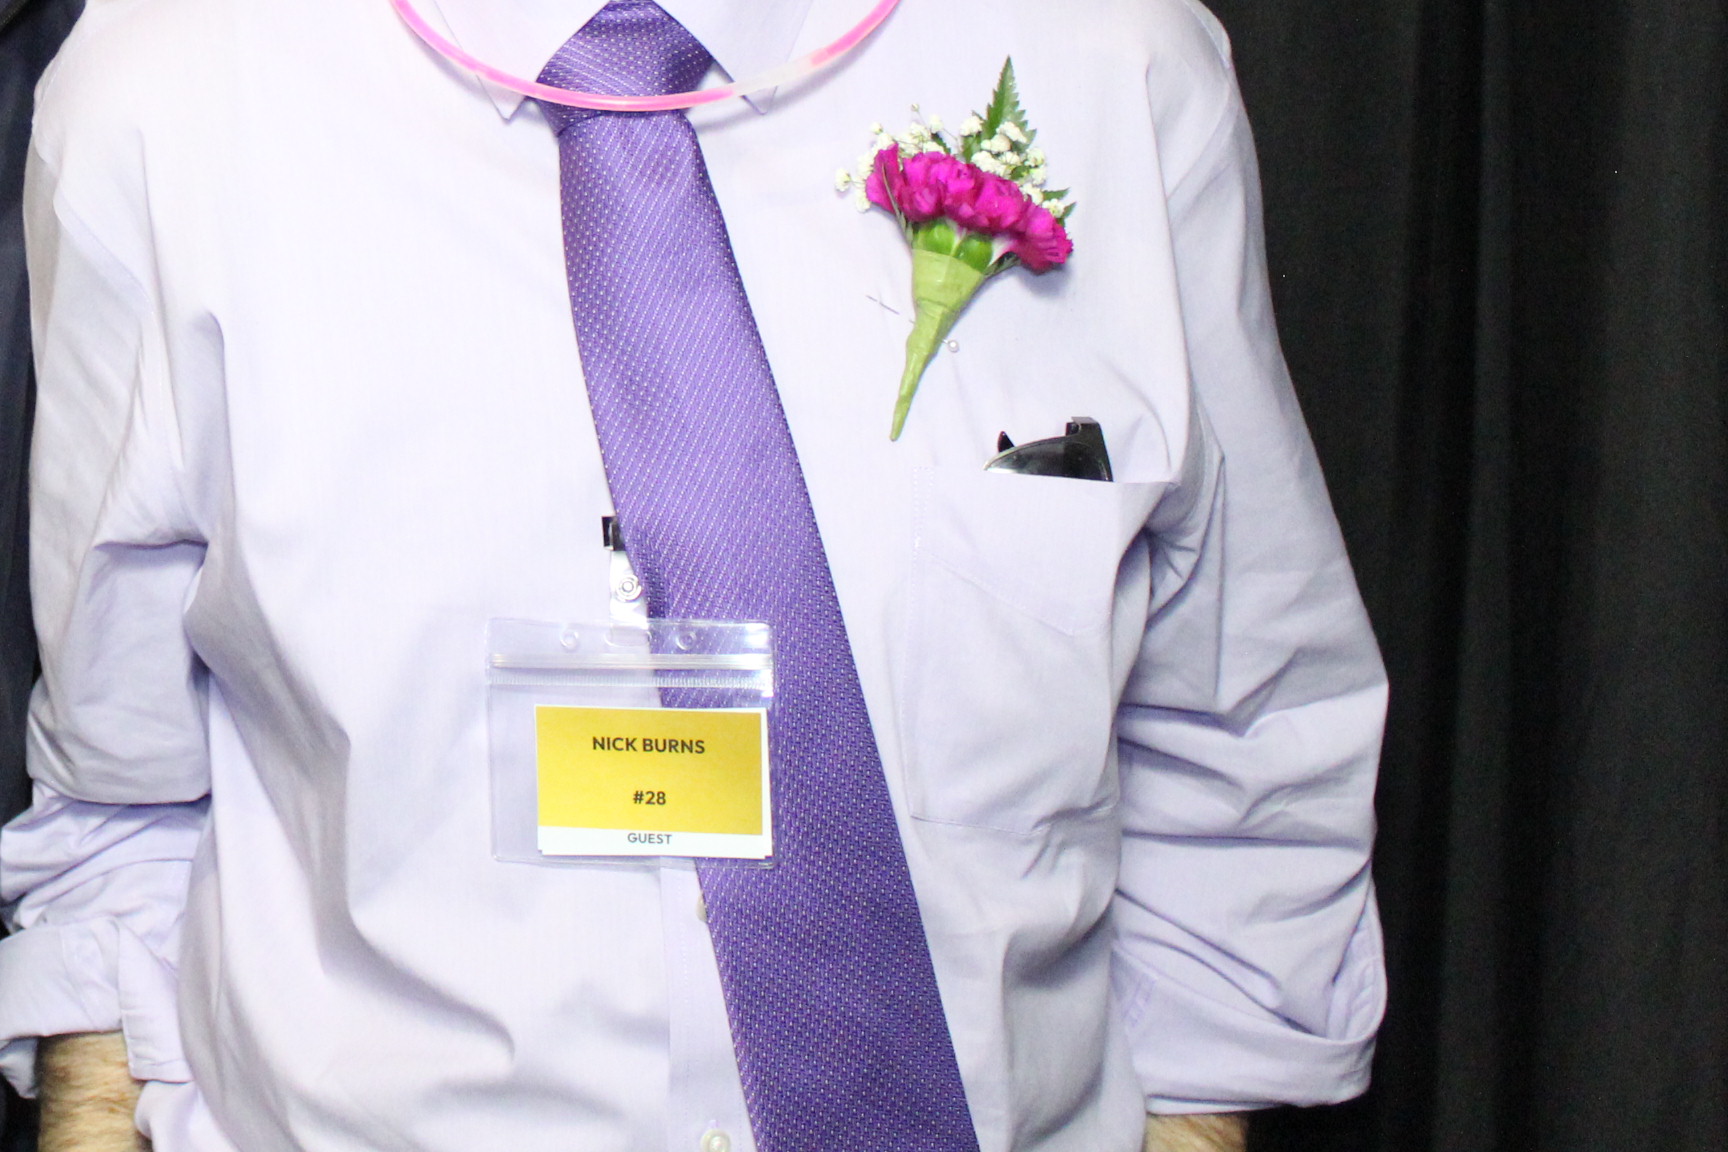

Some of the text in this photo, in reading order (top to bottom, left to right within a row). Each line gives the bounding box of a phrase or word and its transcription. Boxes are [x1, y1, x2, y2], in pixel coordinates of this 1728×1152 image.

[592, 736, 705, 754] NICK BURNS
[633, 790, 666, 805] #28
[627, 832, 672, 845] GUEST
